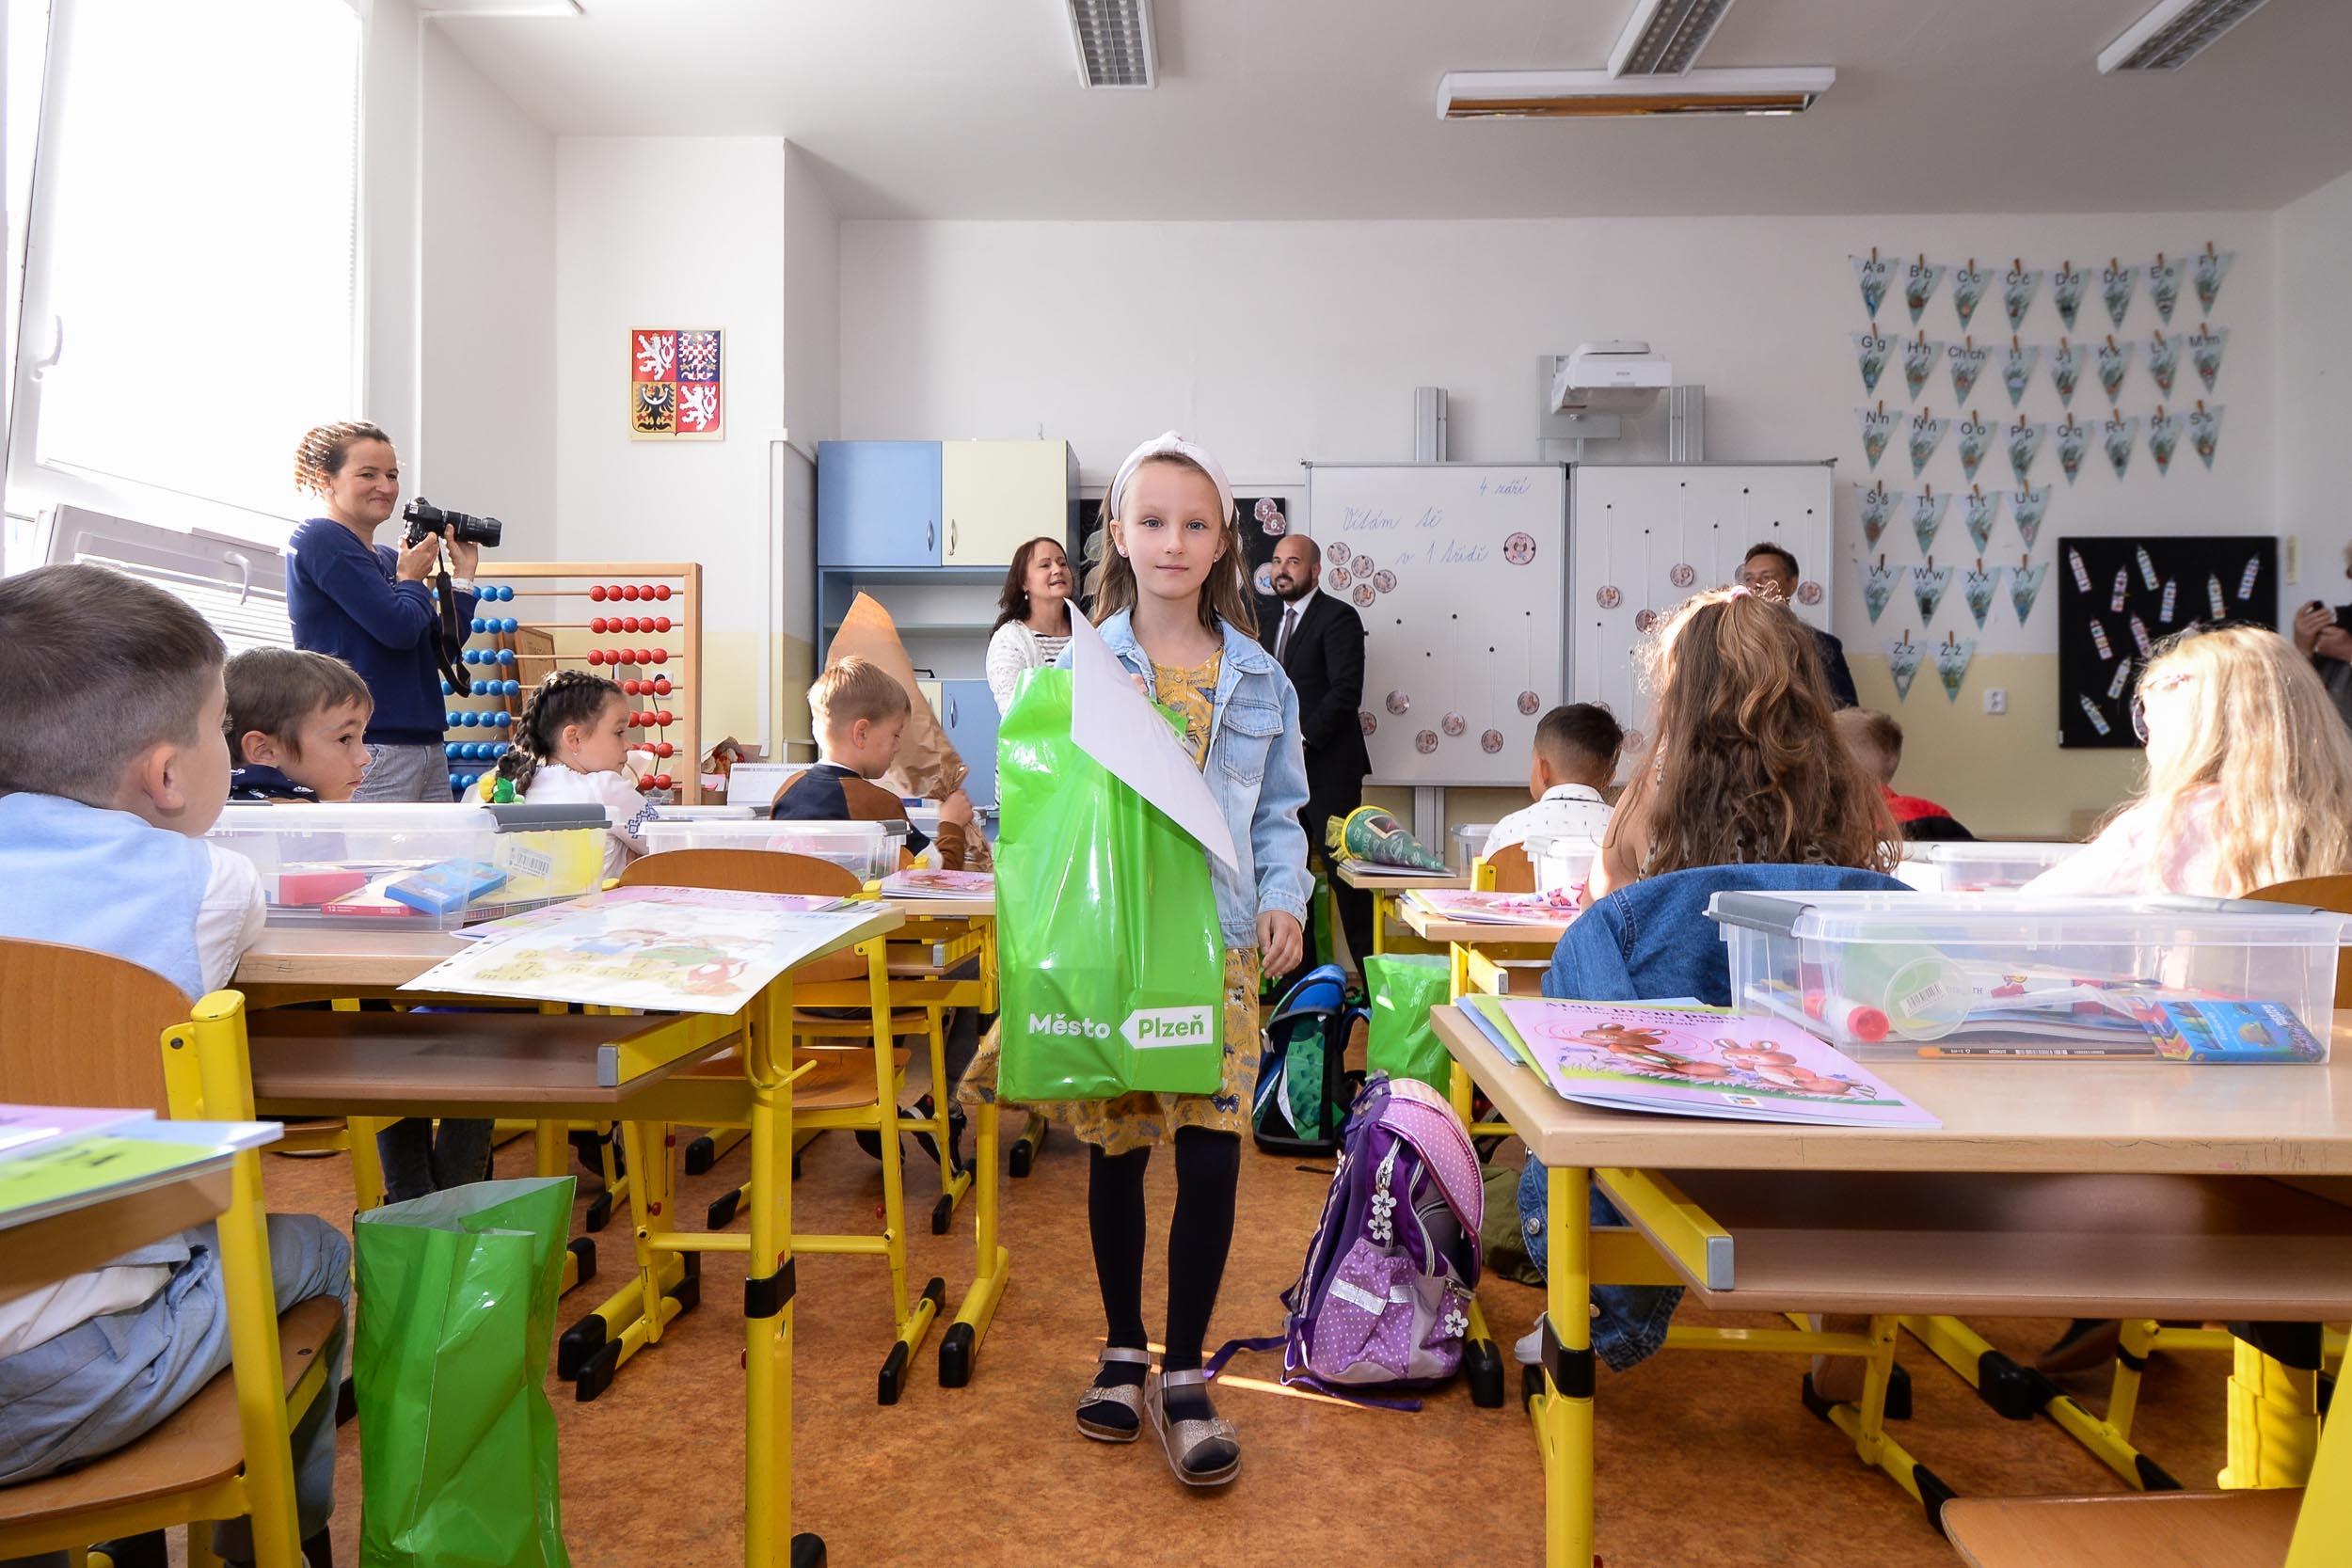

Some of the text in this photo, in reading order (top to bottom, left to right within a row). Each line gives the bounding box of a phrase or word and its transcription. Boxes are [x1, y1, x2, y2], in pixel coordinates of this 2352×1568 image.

[1480, 476, 1486, 496] 4
[1343, 507, 1402, 531] Vítám
[1028, 1013, 1204, 1039] Město Plzeň
